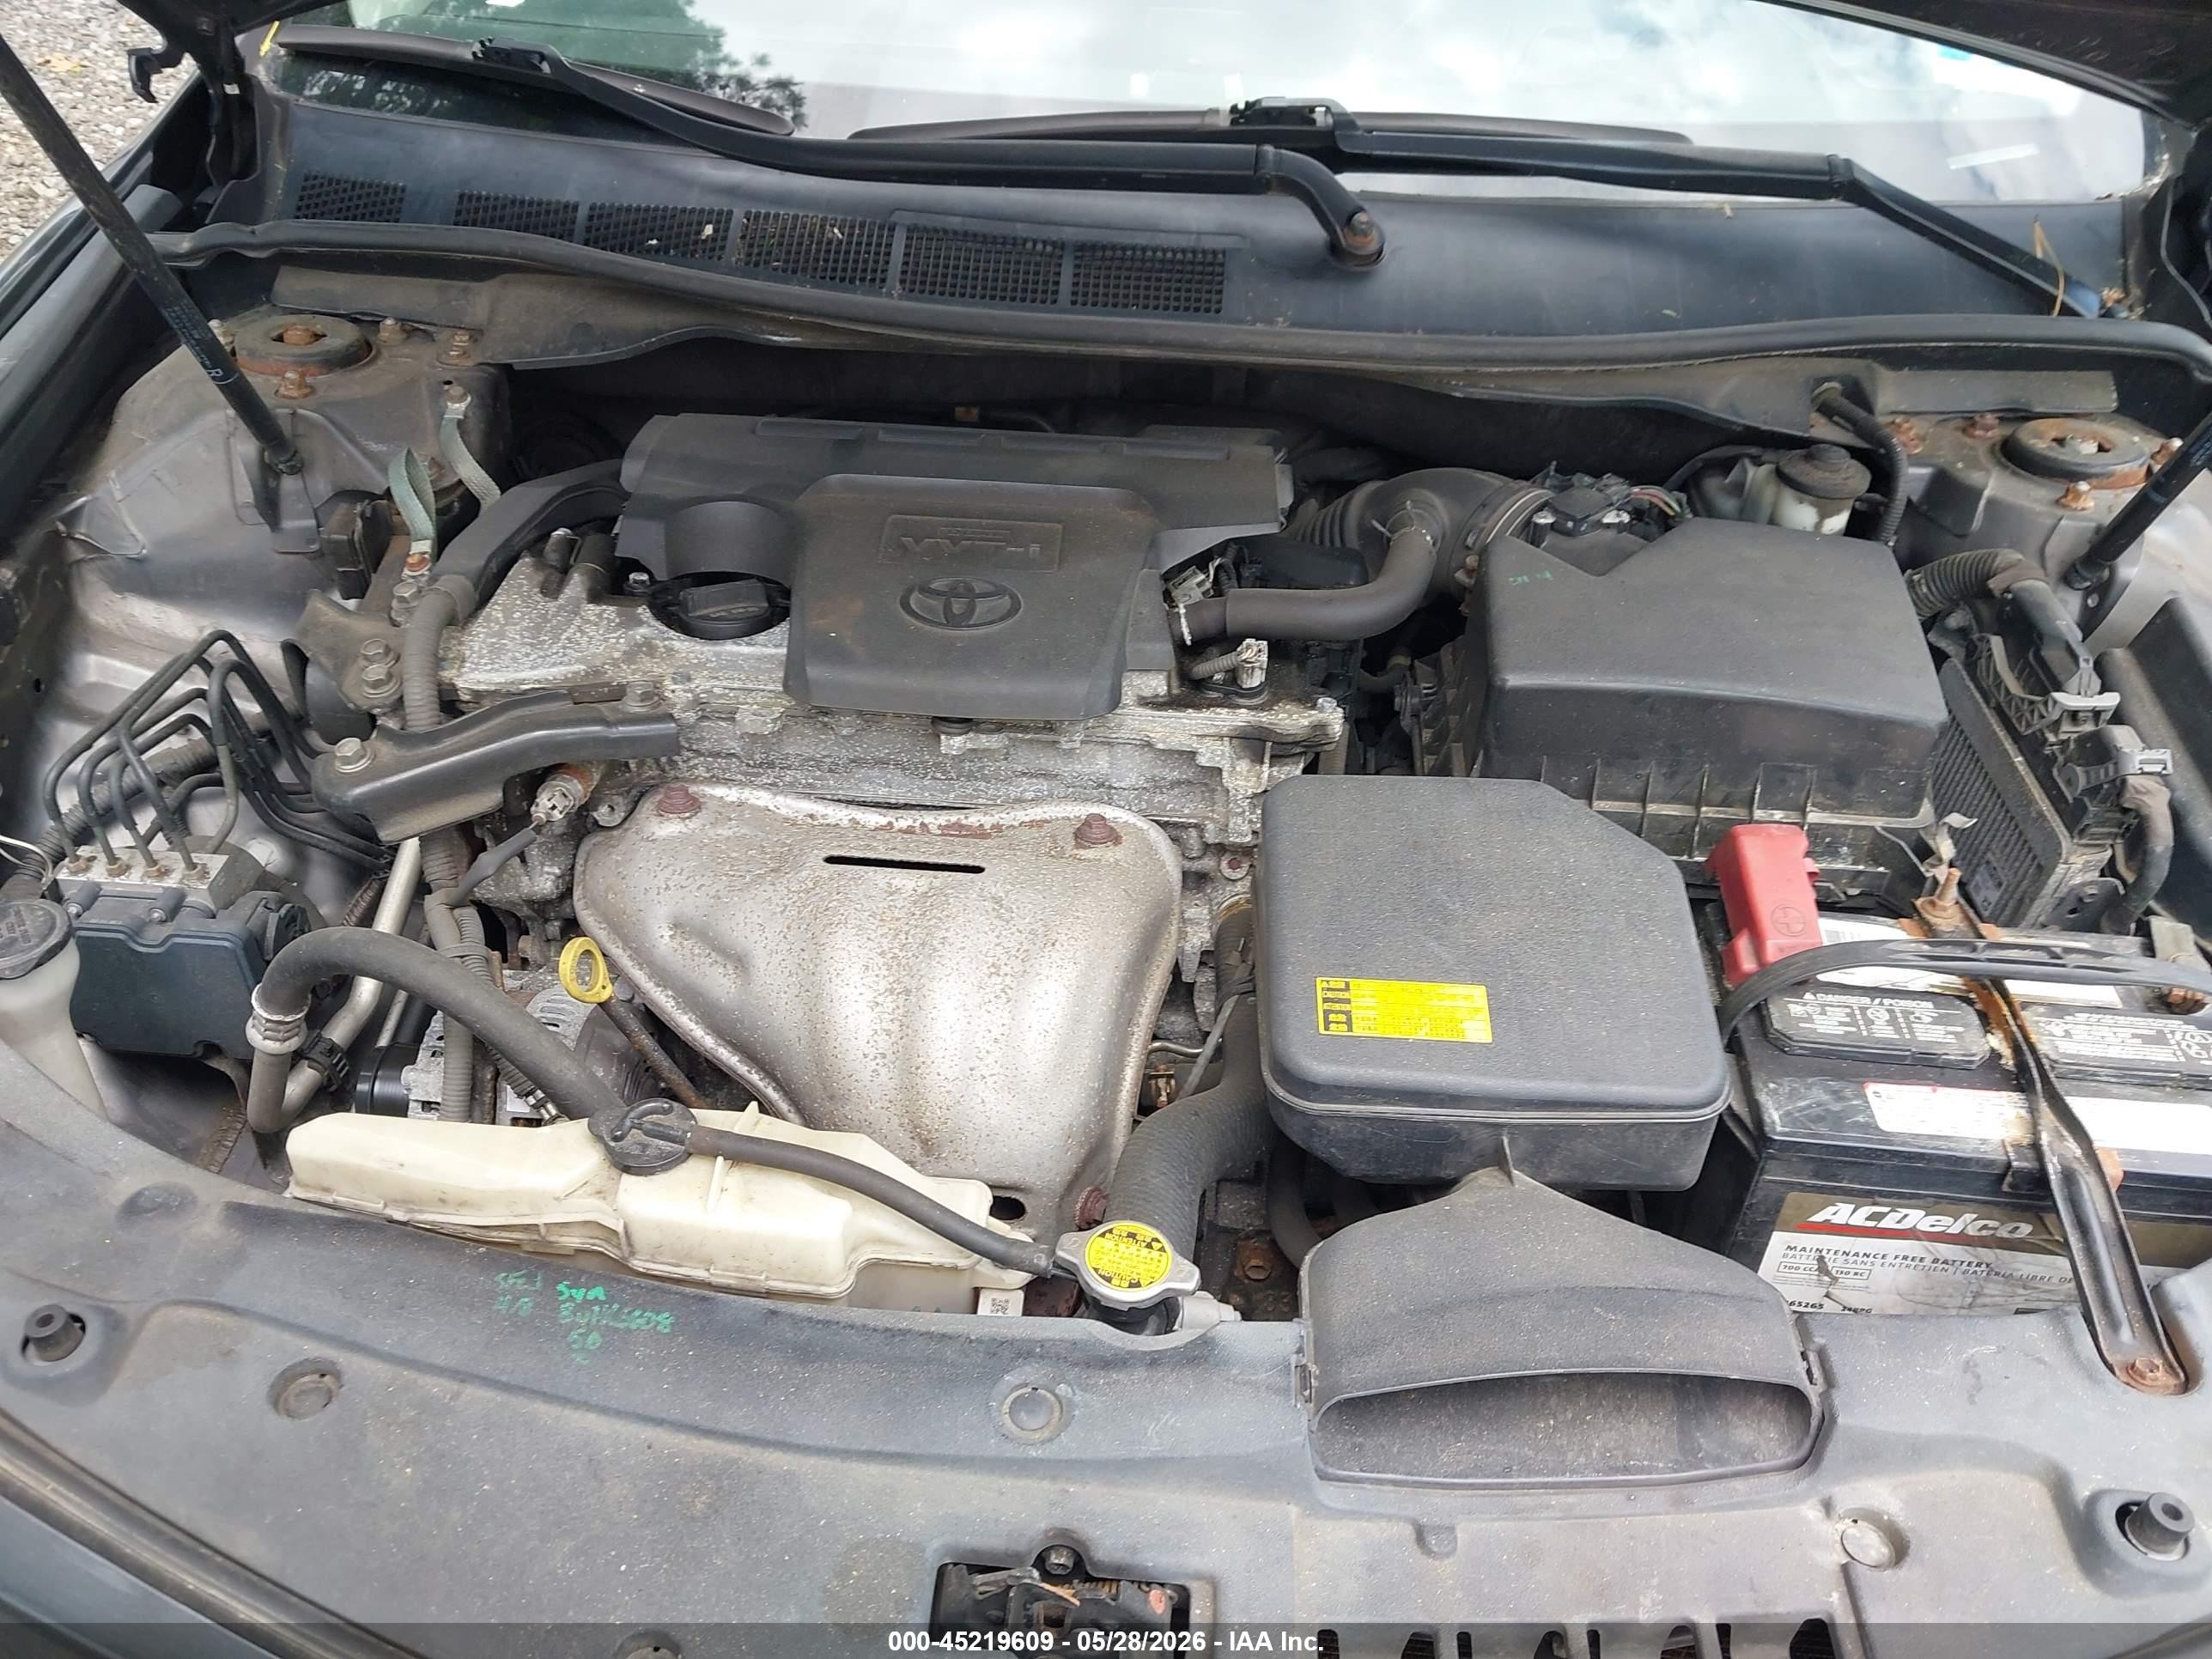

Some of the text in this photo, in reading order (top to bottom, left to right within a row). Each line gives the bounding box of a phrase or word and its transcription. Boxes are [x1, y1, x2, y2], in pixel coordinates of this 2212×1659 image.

[1806, 1202, 2035, 1238] ACDelco
[1104, 1232, 1147, 1248] ATTENTION
[1785, 1245, 1993, 1270] MAINTENANCE FREE BATTERY
[1097, 1268, 1139, 1284] CAUTION
[1842, 1258, 1875, 1267] SANS
[1881, 1261, 1950, 1273] ENTRETIEN
[2020, 1273, 2056, 1283] LIBRE
